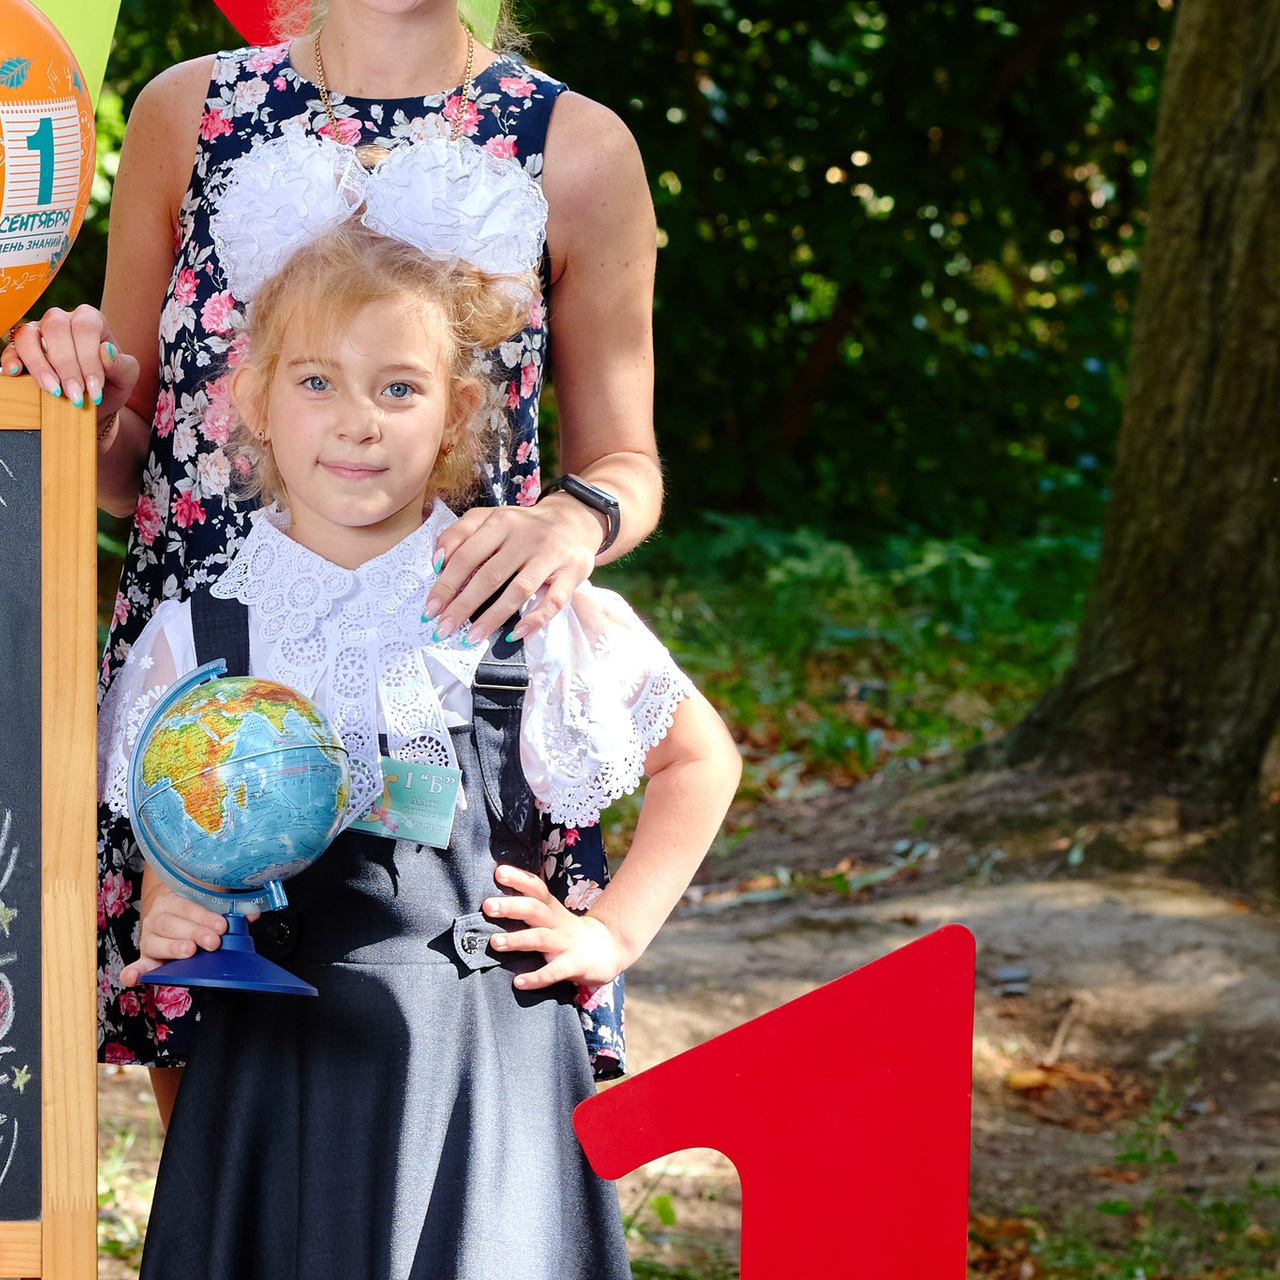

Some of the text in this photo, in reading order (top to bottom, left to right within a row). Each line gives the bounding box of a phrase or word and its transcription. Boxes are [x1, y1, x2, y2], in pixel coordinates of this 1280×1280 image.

[26, 117, 55, 206] 1
[26, 236, 61, 251] ЗНАНИЙ
[405, 771, 414, 789] 1
